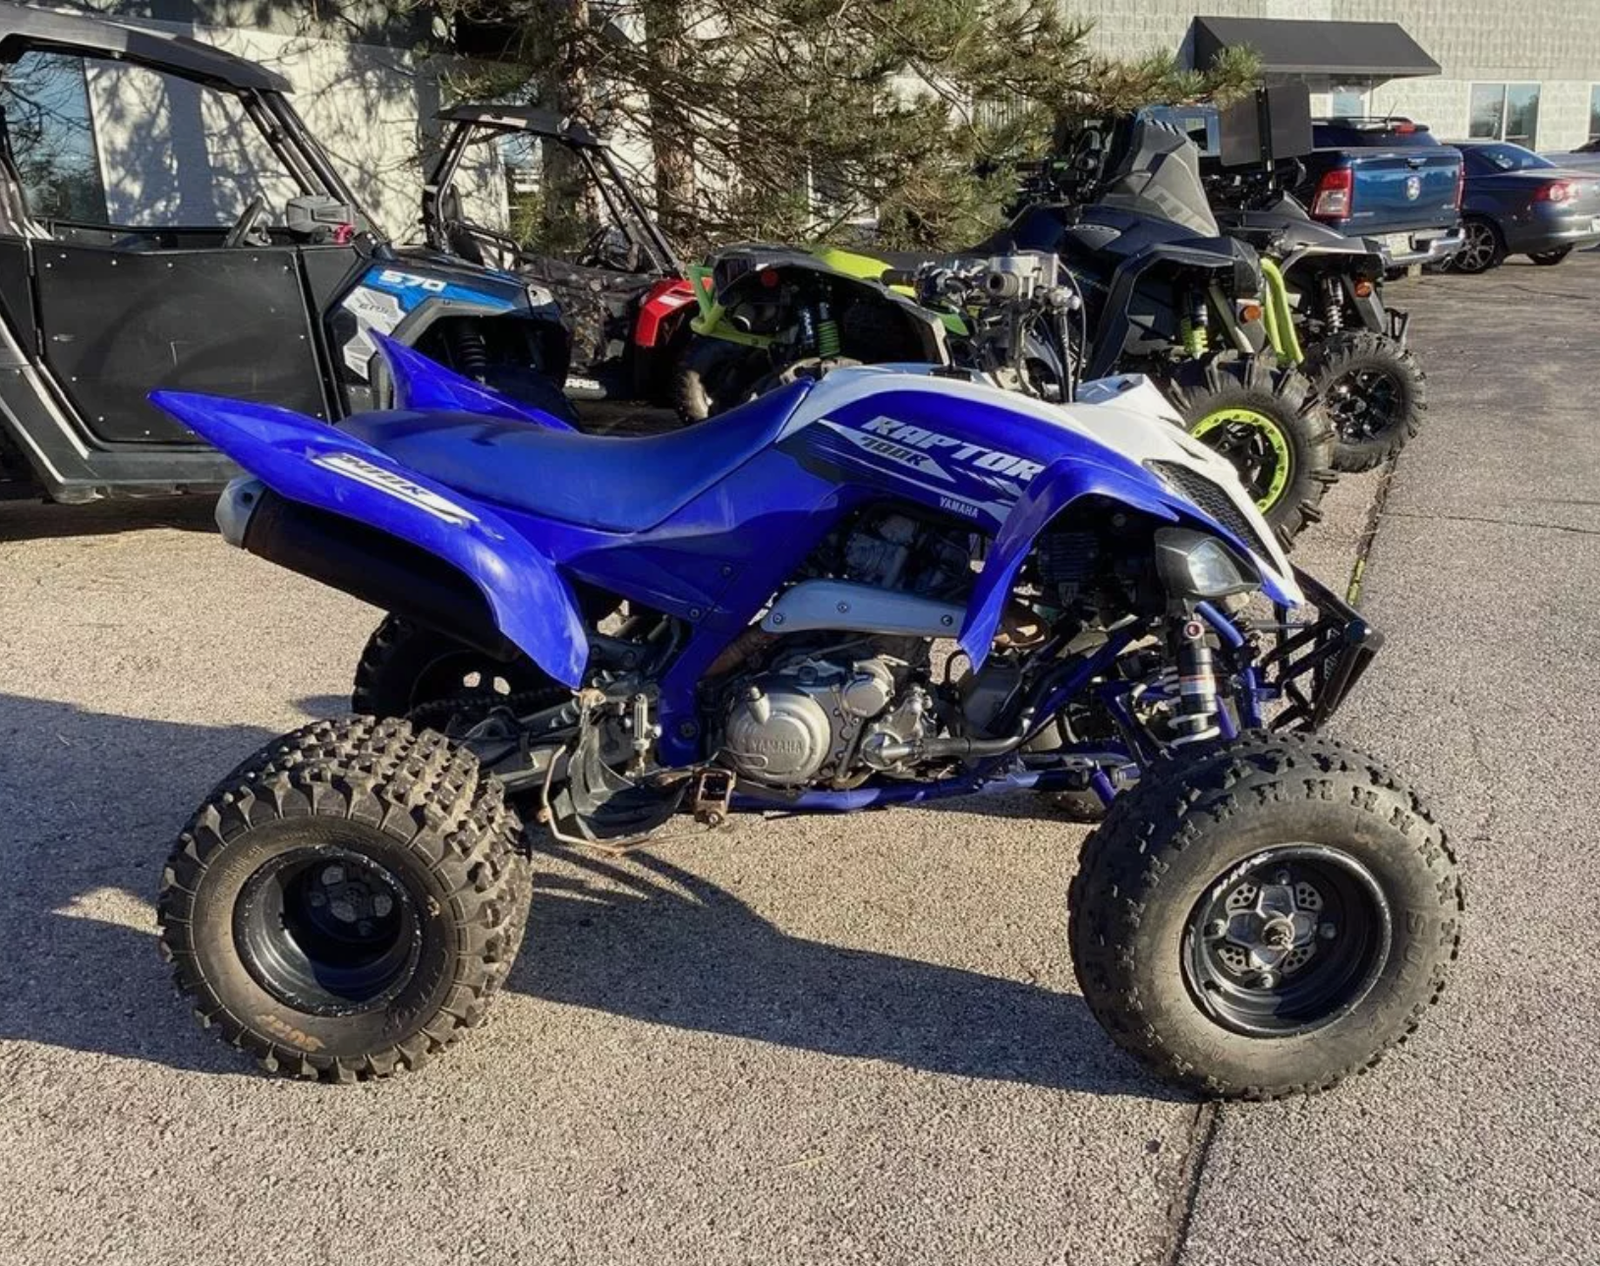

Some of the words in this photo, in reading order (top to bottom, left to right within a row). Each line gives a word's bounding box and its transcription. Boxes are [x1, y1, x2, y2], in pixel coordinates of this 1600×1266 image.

[379, 269, 446, 291] 570
[861, 415, 1046, 481] RAPTOR
[939, 496, 979, 519] YAMAHA
[750, 739, 804, 753] YAMAHA
